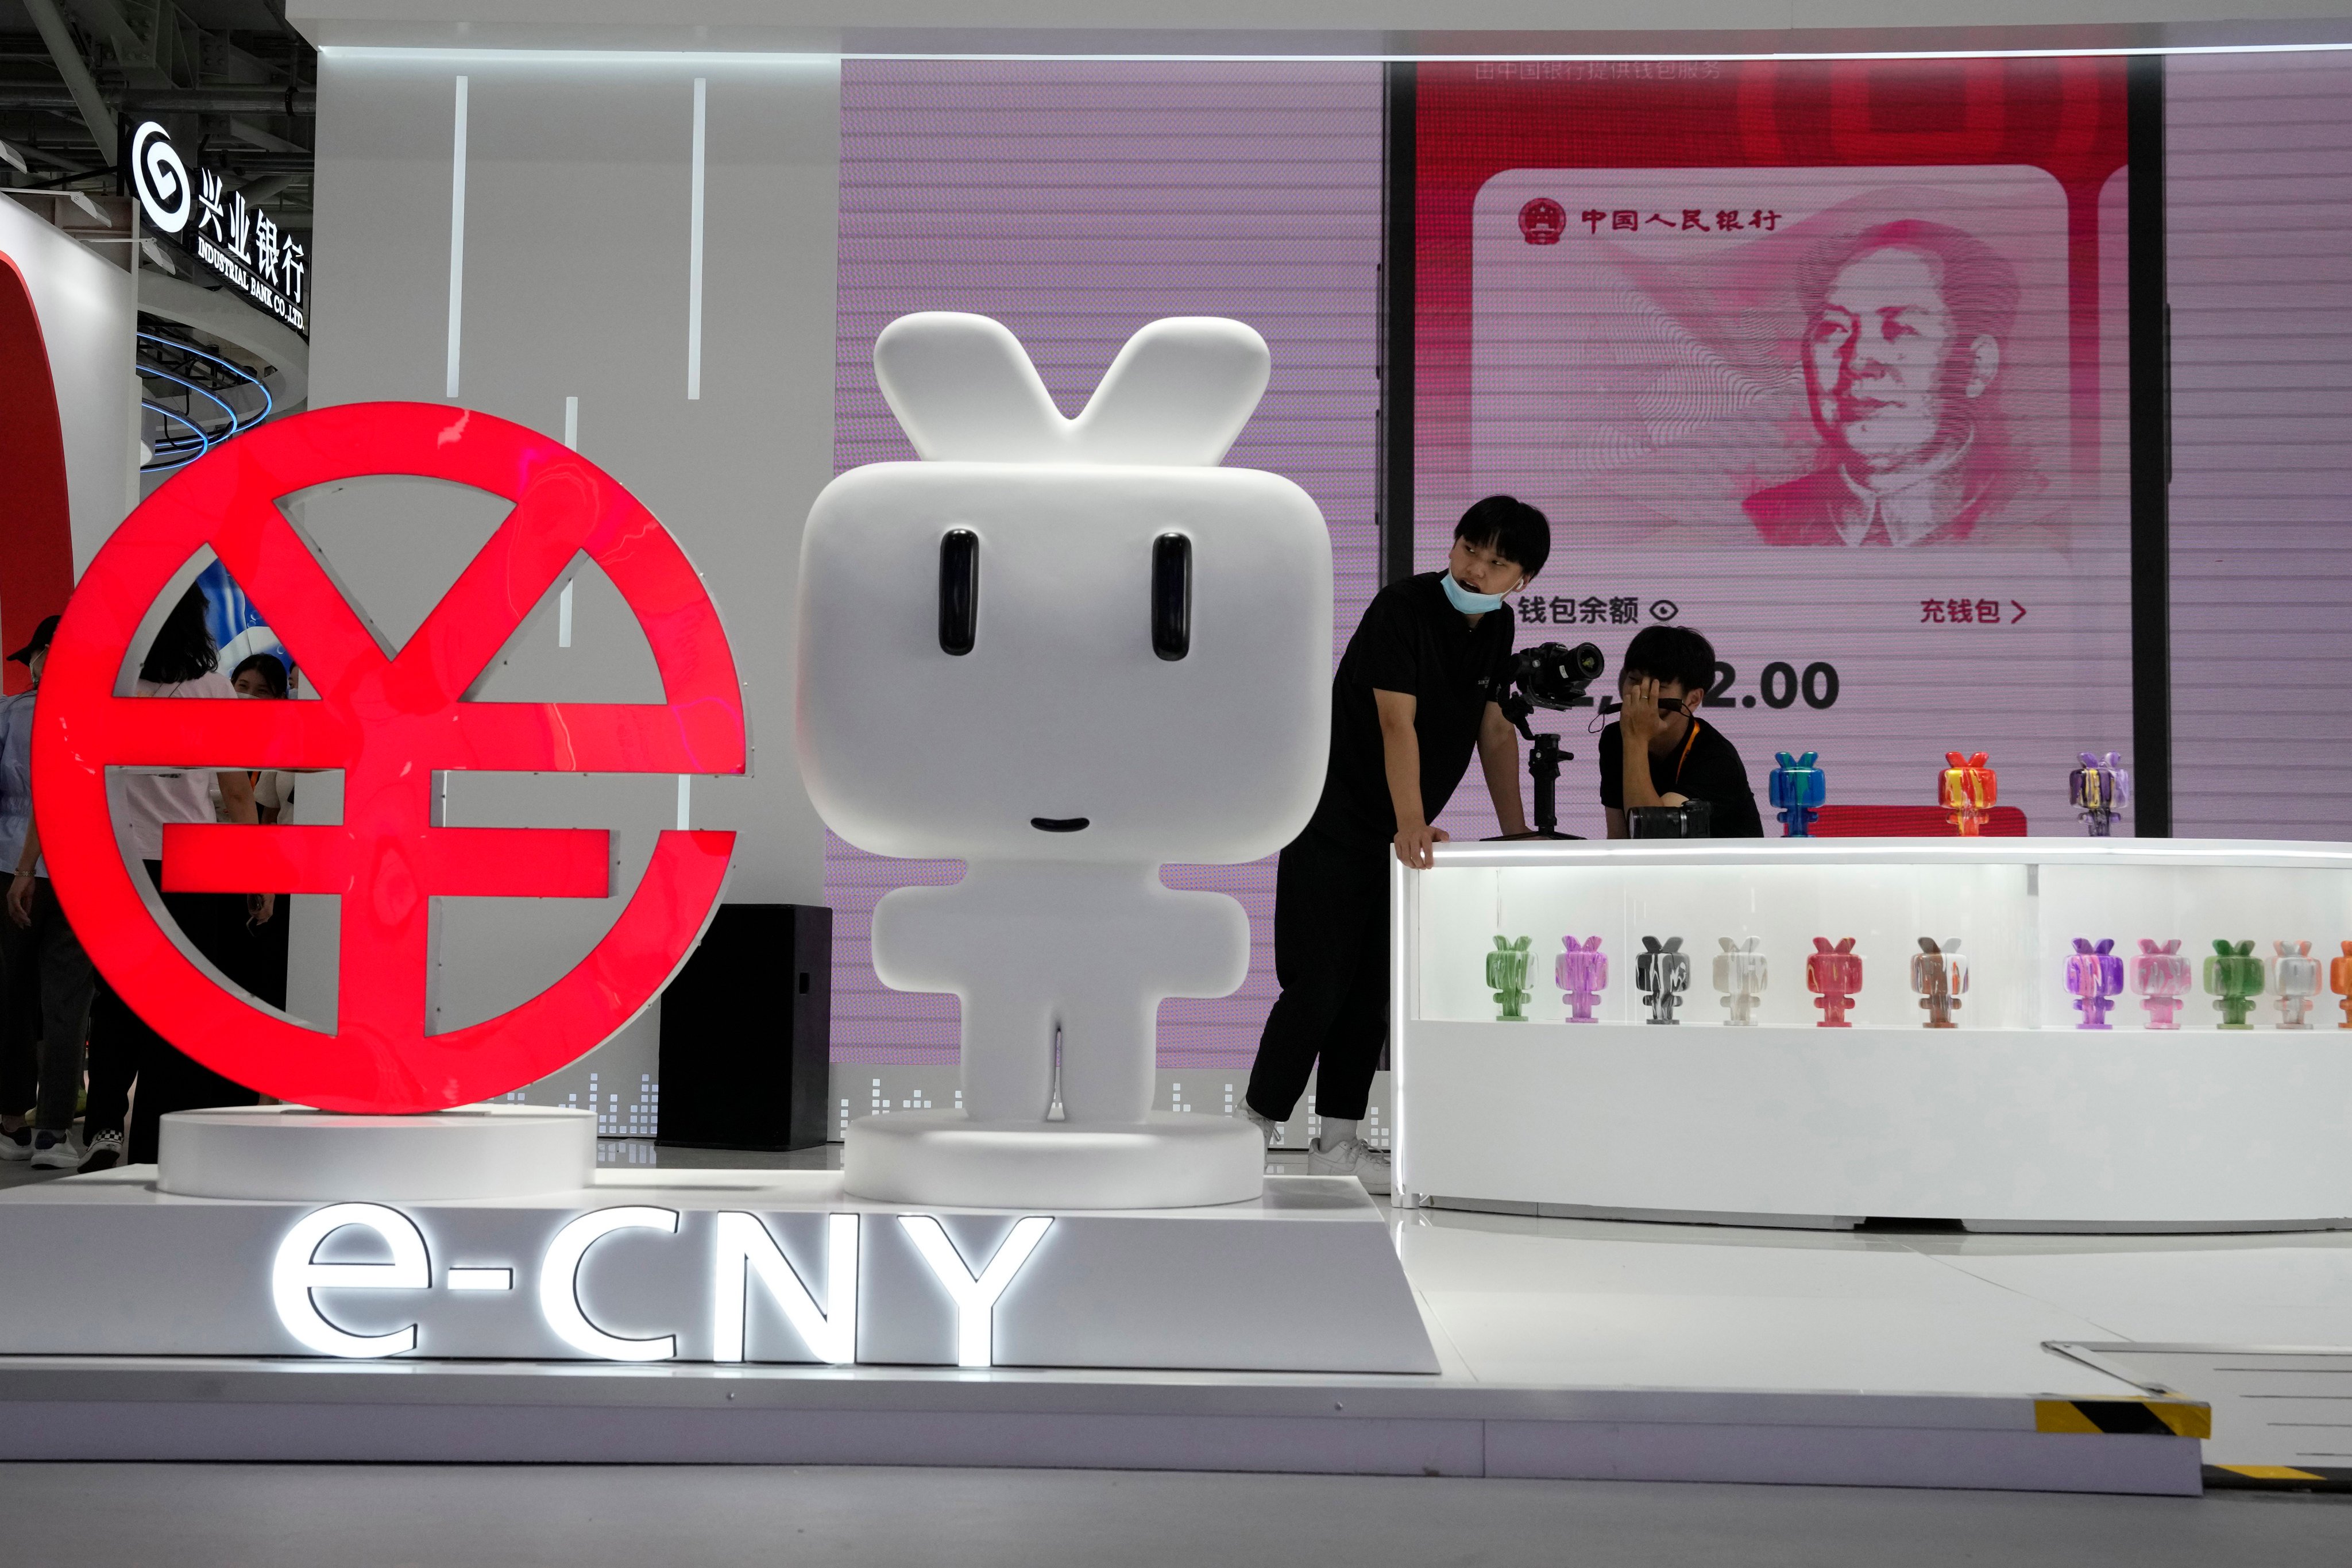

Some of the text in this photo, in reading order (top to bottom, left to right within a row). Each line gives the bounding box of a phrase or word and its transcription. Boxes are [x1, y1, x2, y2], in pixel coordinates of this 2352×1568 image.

[1476, 61, 1720, 80] 由中国银行提供钱包服务
[199, 167, 304, 303] 兴业银行
[1581, 208, 1782, 234] 中国人民银行
[198, 236, 249, 291] INDUSTRIAL
[250, 277, 273, 308] BANK
[1518, 596, 1639, 624] 钱包余额
[1920, 598, 2000, 623] 充钱包
[272, 1202, 1056, 1368] e-CNY
